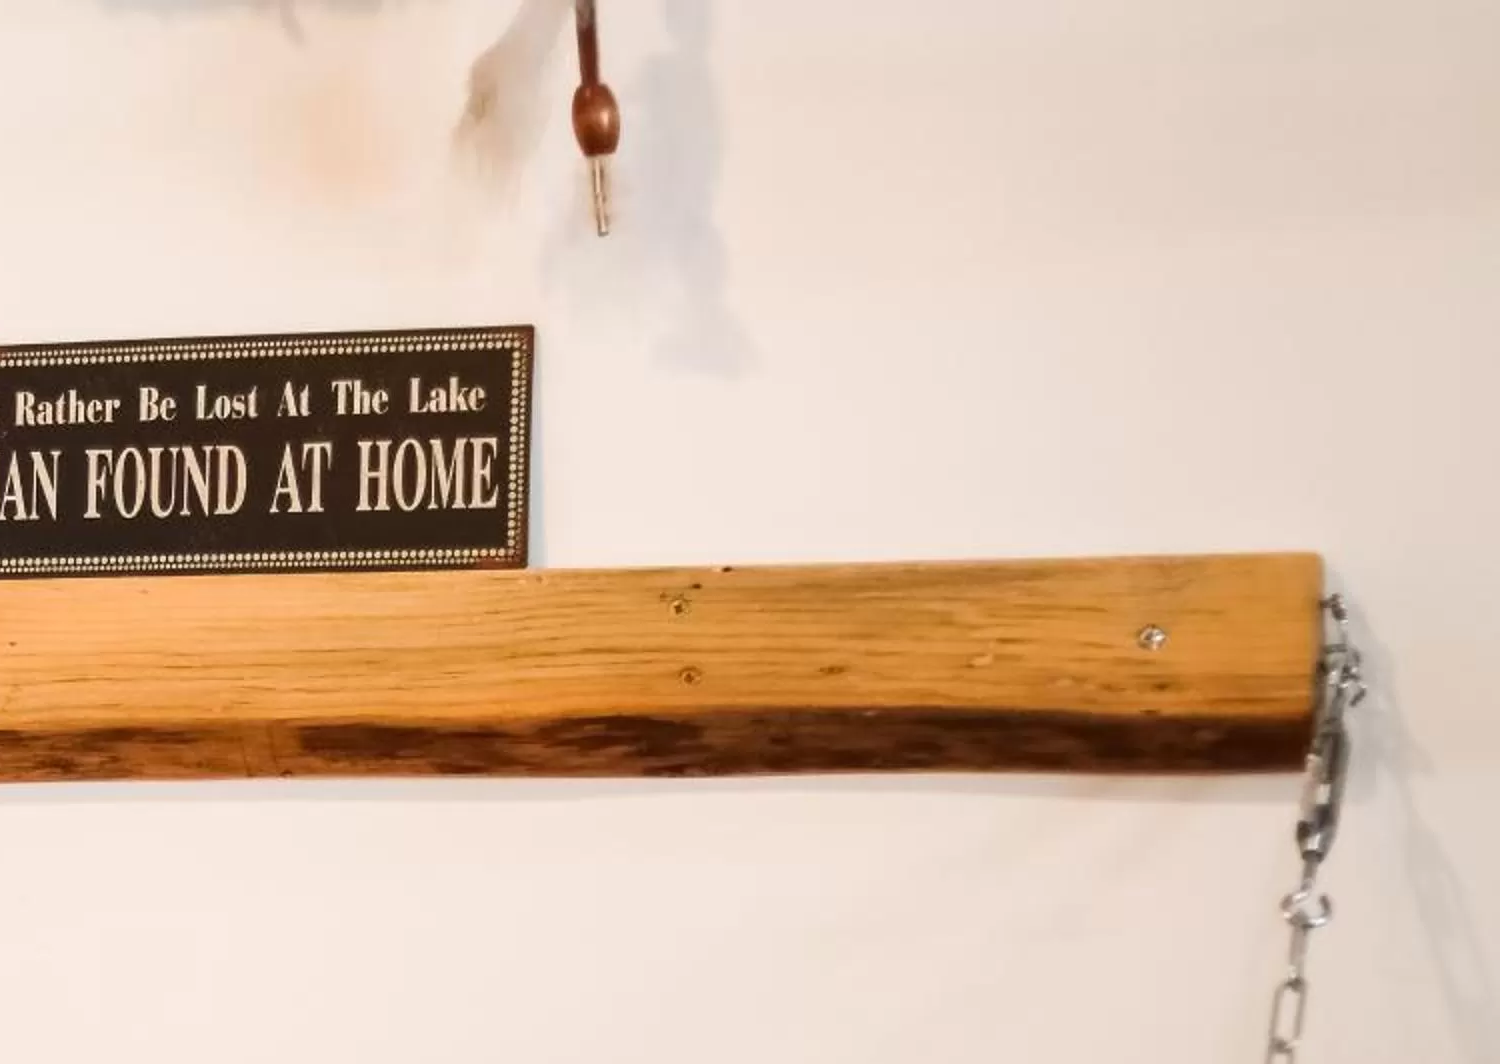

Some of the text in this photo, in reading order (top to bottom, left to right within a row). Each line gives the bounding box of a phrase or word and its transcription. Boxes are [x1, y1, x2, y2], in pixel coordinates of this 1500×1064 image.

[14, 387, 120, 427] Rather
[139, 386, 177, 422] Be
[195, 384, 259, 421] Lost
[277, 380, 311, 417] At
[331, 378, 389, 416] The
[409, 375, 486, 414] Lake
[83, 445, 248, 519] FOUND
[269, 441, 333, 514] AT
[355, 436, 499, 512] HOME
